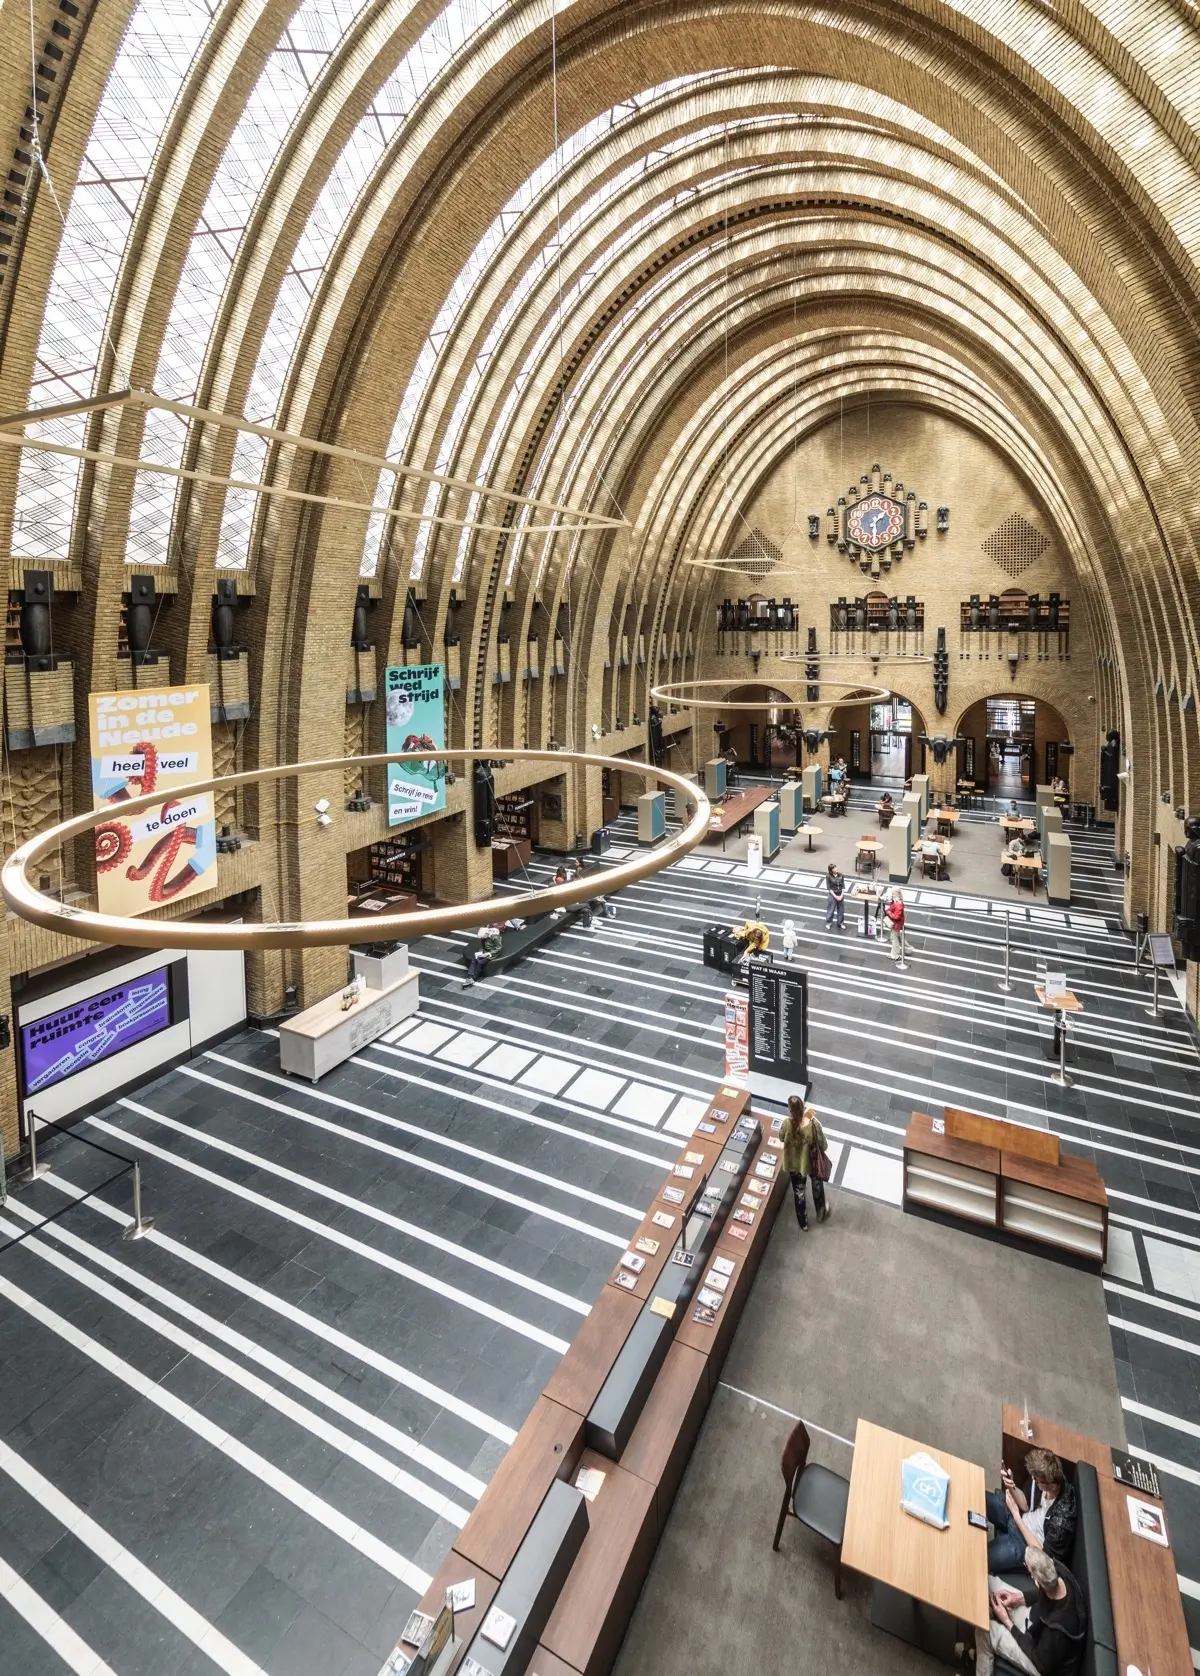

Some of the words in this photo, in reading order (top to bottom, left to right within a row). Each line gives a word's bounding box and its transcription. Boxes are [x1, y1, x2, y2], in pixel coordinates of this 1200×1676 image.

[389, 667, 439, 681] Schrijf
[389, 680, 422, 691] wed
[398, 689, 439, 703] strijd
[96, 691, 199, 713] Zomer
[97, 711, 129, 731] in
[135, 709, 174, 726] de
[98, 722, 198, 748] Neude
[111, 760, 145, 772] heel
[160, 757, 189, 770] veel
[393, 783, 415, 796] Schrijf
[414, 789, 422, 798] je
[422, 792, 434, 801] reis
[146, 821, 160, 832] te
[163, 806, 197, 825] doen
[404, 805, 418, 814] win!
[768, 968, 787, 976] WAAR?
[131, 986, 150, 996] lezing
[29, 1007, 84, 1038] Huur
[87, 991, 124, 1012] een
[98, 1002, 132, 1028] brainstorm
[118, 1000, 166, 1030] boekpresentatie
[29, 1010, 105, 1050] ruimte
[78, 1031, 105, 1050] congres
[91, 1033, 114, 1058] borrelen
[32, 1055, 71, 1087] vergaderen
[63, 1049, 90, 1072] receptie
